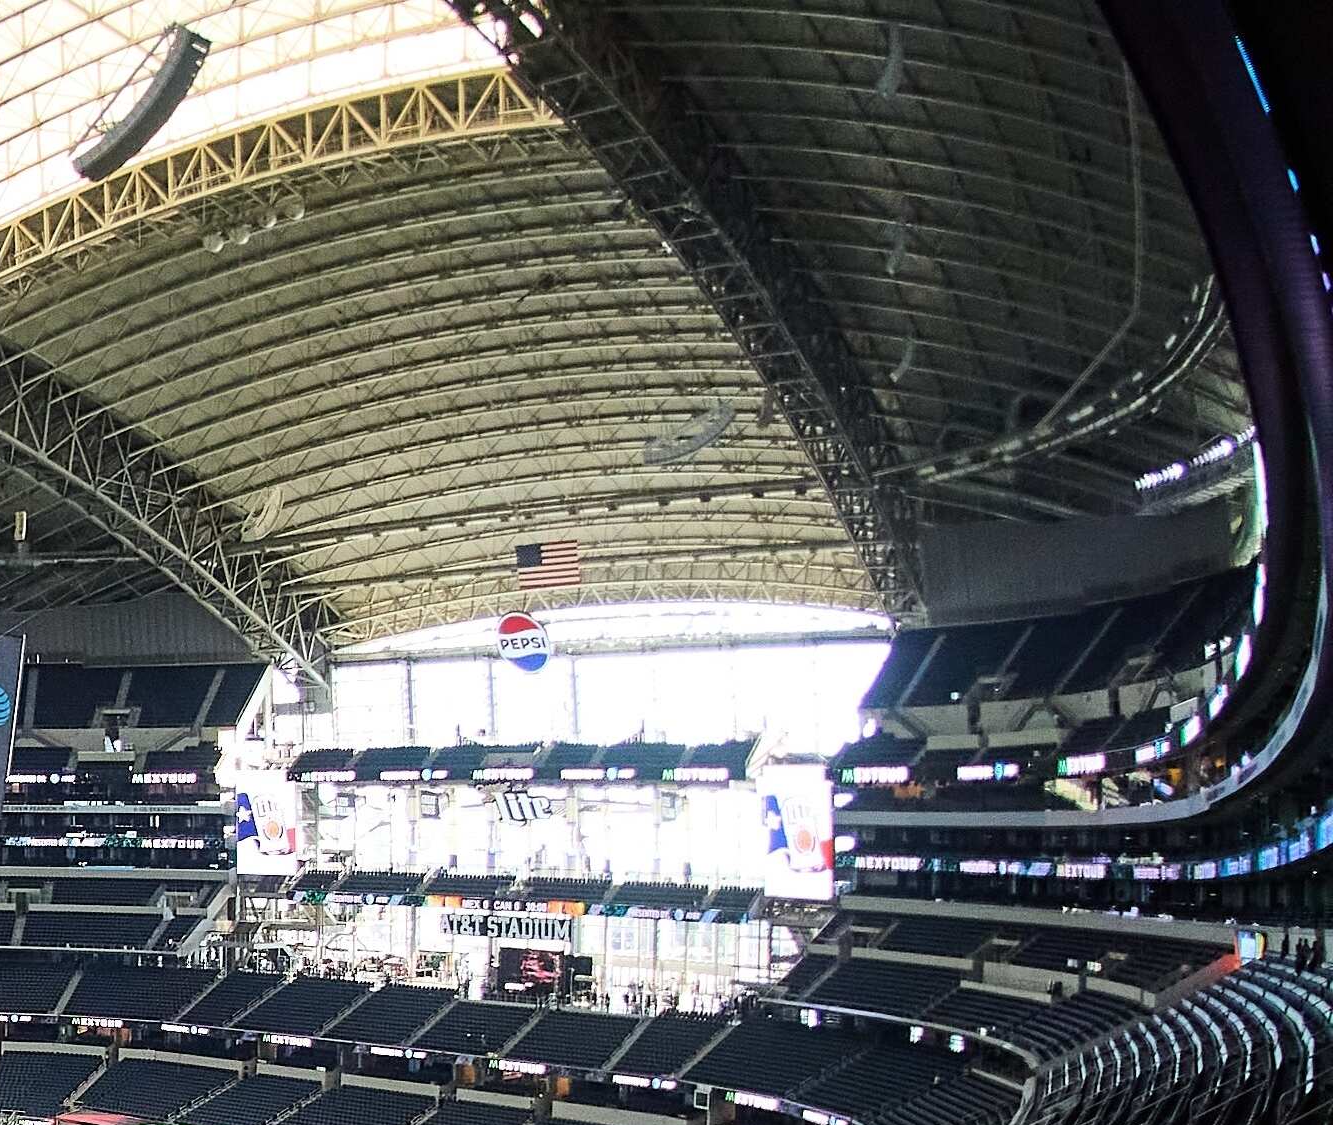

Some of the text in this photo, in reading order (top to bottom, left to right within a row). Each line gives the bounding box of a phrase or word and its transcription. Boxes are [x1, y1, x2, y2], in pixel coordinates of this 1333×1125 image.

[499, 637, 547, 650] PEPSI
[140, 838, 204, 849] MEXTOUR
[493, 901, 513, 912] CAN
[440, 914, 570, 942] AT&T STADIUM
[71, 1017, 123, 1028] MEXTOUR
[262, 1034, 312, 1047] MEXTOUR
